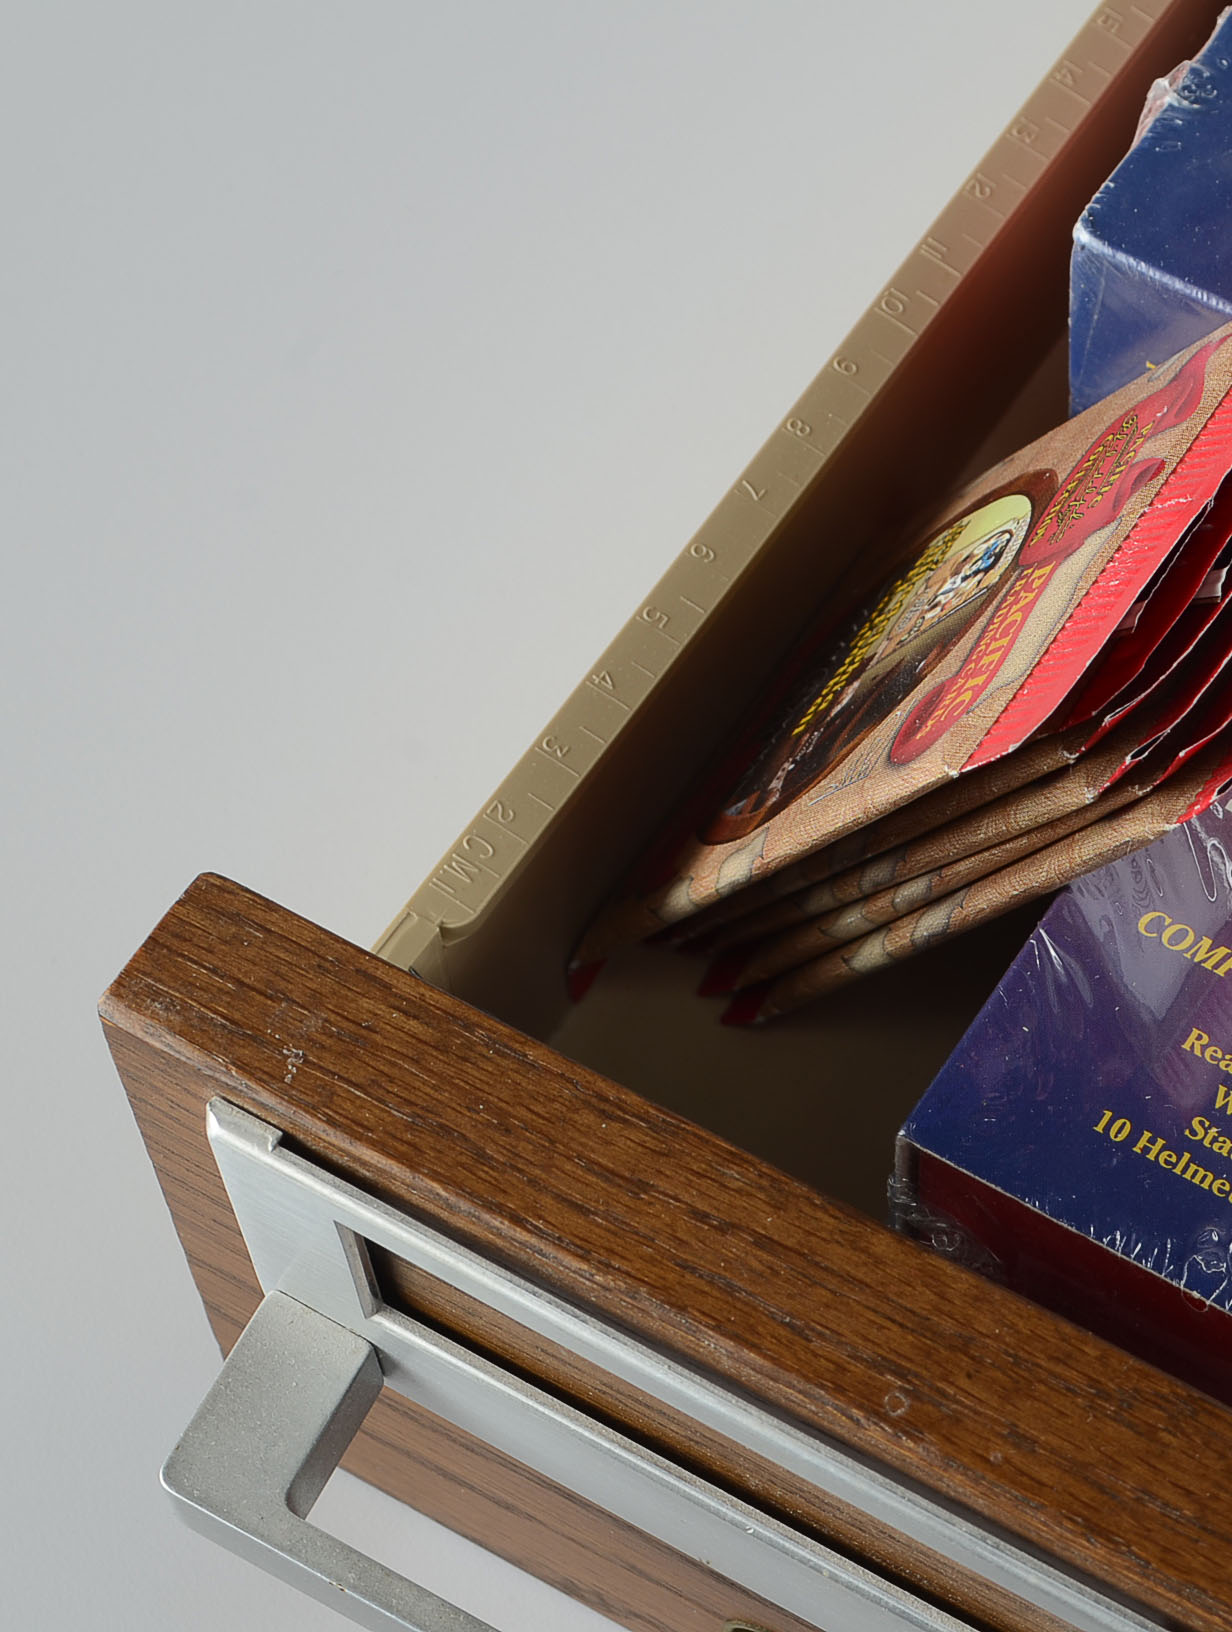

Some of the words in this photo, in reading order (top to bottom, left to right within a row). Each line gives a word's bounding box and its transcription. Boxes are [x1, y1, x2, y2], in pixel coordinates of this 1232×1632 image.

[941, 561, 1056, 721] PACIFIC
[971, 564, 1034, 661] TRADING
[1093, 1110, 1132, 1142] 10
